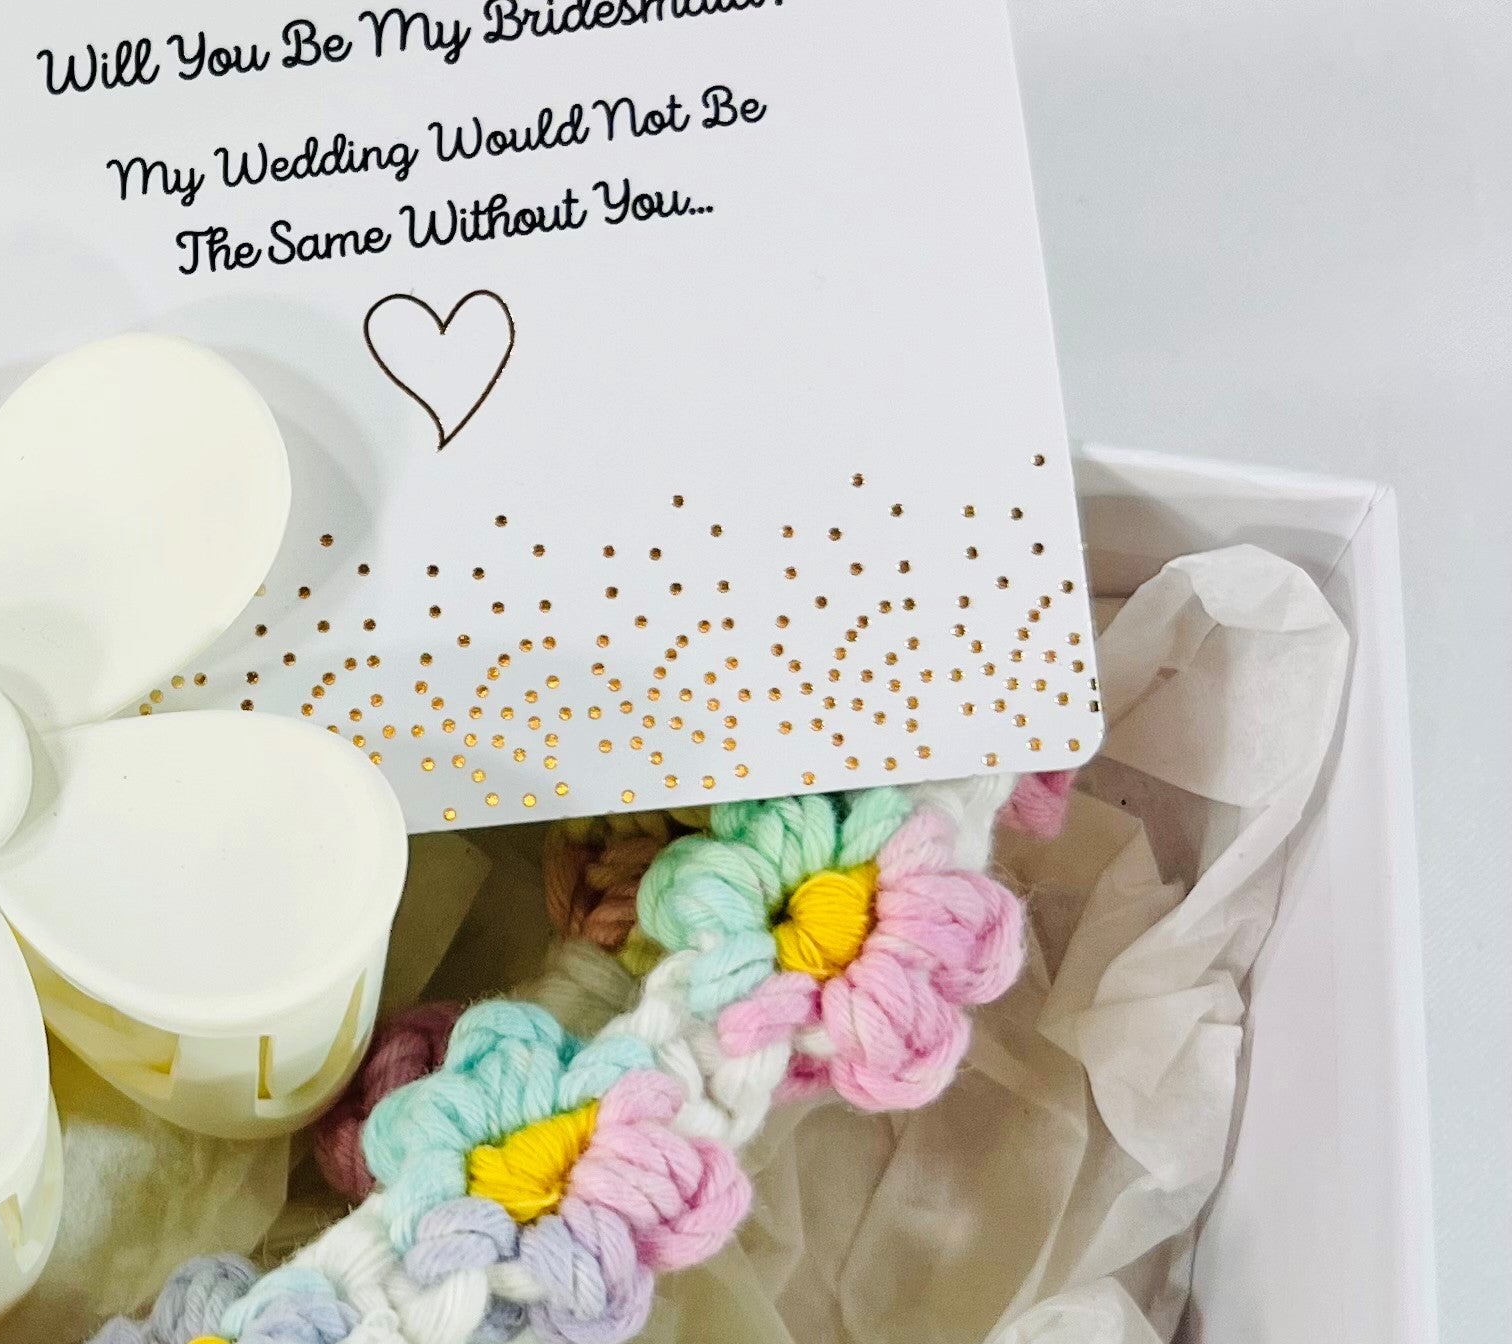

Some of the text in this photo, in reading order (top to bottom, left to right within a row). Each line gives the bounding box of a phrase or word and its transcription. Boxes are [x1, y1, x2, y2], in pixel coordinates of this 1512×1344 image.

[38, 43, 159, 94] Will
[167, 32, 270, 82] You
[282, 18, 352, 67] Be
[359, 8, 470, 63] My
[108, 85, 766, 206] My Wedding Would Not Be
[176, 228, 262, 275] The
[267, 221, 392, 266] Same
[400, 188, 588, 248] Without
